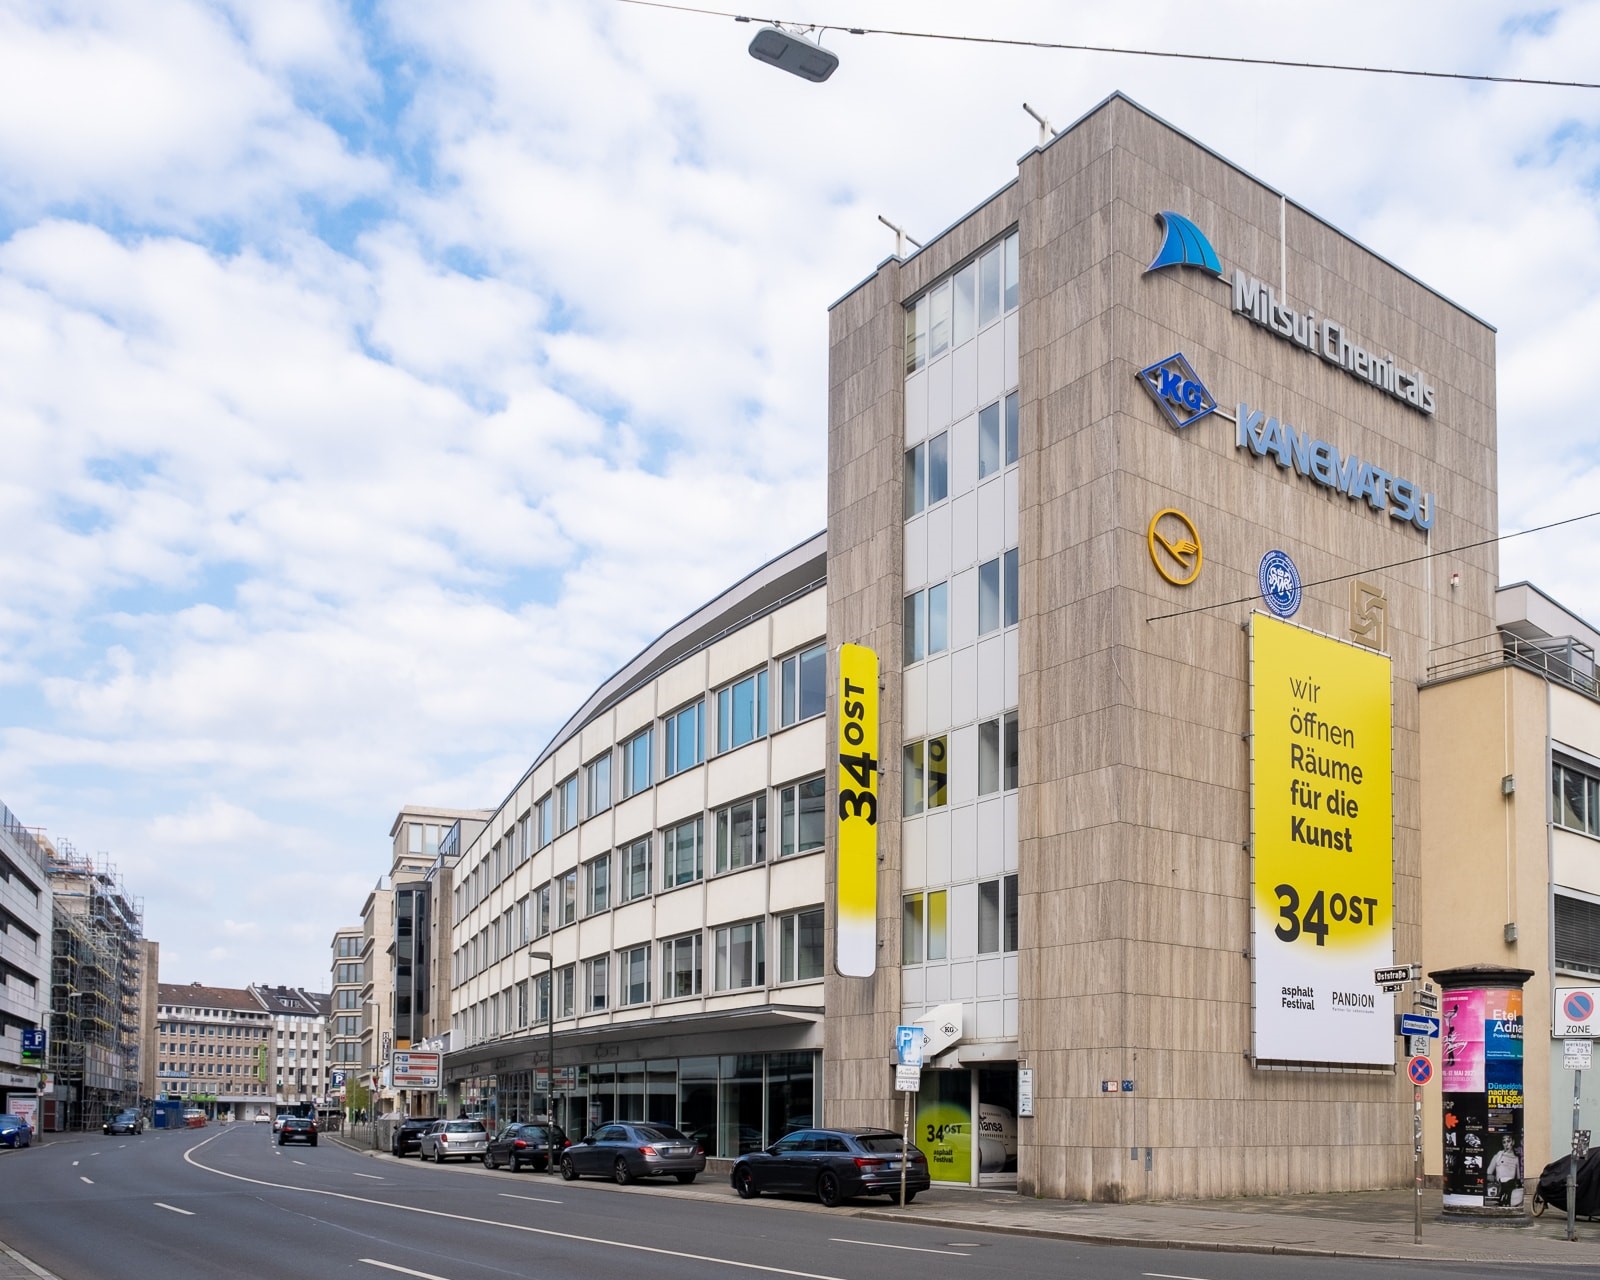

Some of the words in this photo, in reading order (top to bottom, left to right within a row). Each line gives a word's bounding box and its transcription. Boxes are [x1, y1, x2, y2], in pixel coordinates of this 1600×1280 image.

[1231, 268, 1316, 352] Mitsui
[1319, 317, 1436, 416] Chemicals
[1159, 366, 1204, 412] KG
[1235, 402, 1435, 531] KANEMATSU
[1289, 676, 1321, 704] wir
[1289, 706, 1355, 750] öffnen
[1290, 743, 1363, 785] Räume
[1290, 778, 1322, 811] für
[1326, 788, 1359, 819] die
[1290, 815, 1353, 853] Kunst
[1376, 970, 1406, 981] Oststraße
[1281, 985, 1314, 998] asphalt
[1281, 997, 1315, 1011] Festival
[1493, 1009, 1517, 1021] Etel
[1493, 1021, 1523, 1033] Adna
[1565, 1025, 1591, 1034] ZONE
[1488, 1088, 1508, 1096] nacht
[1509, 1088, 1518, 1096] der
[933, 1149, 953, 1157] asphalt
[933, 1155, 954, 1163] Festival
